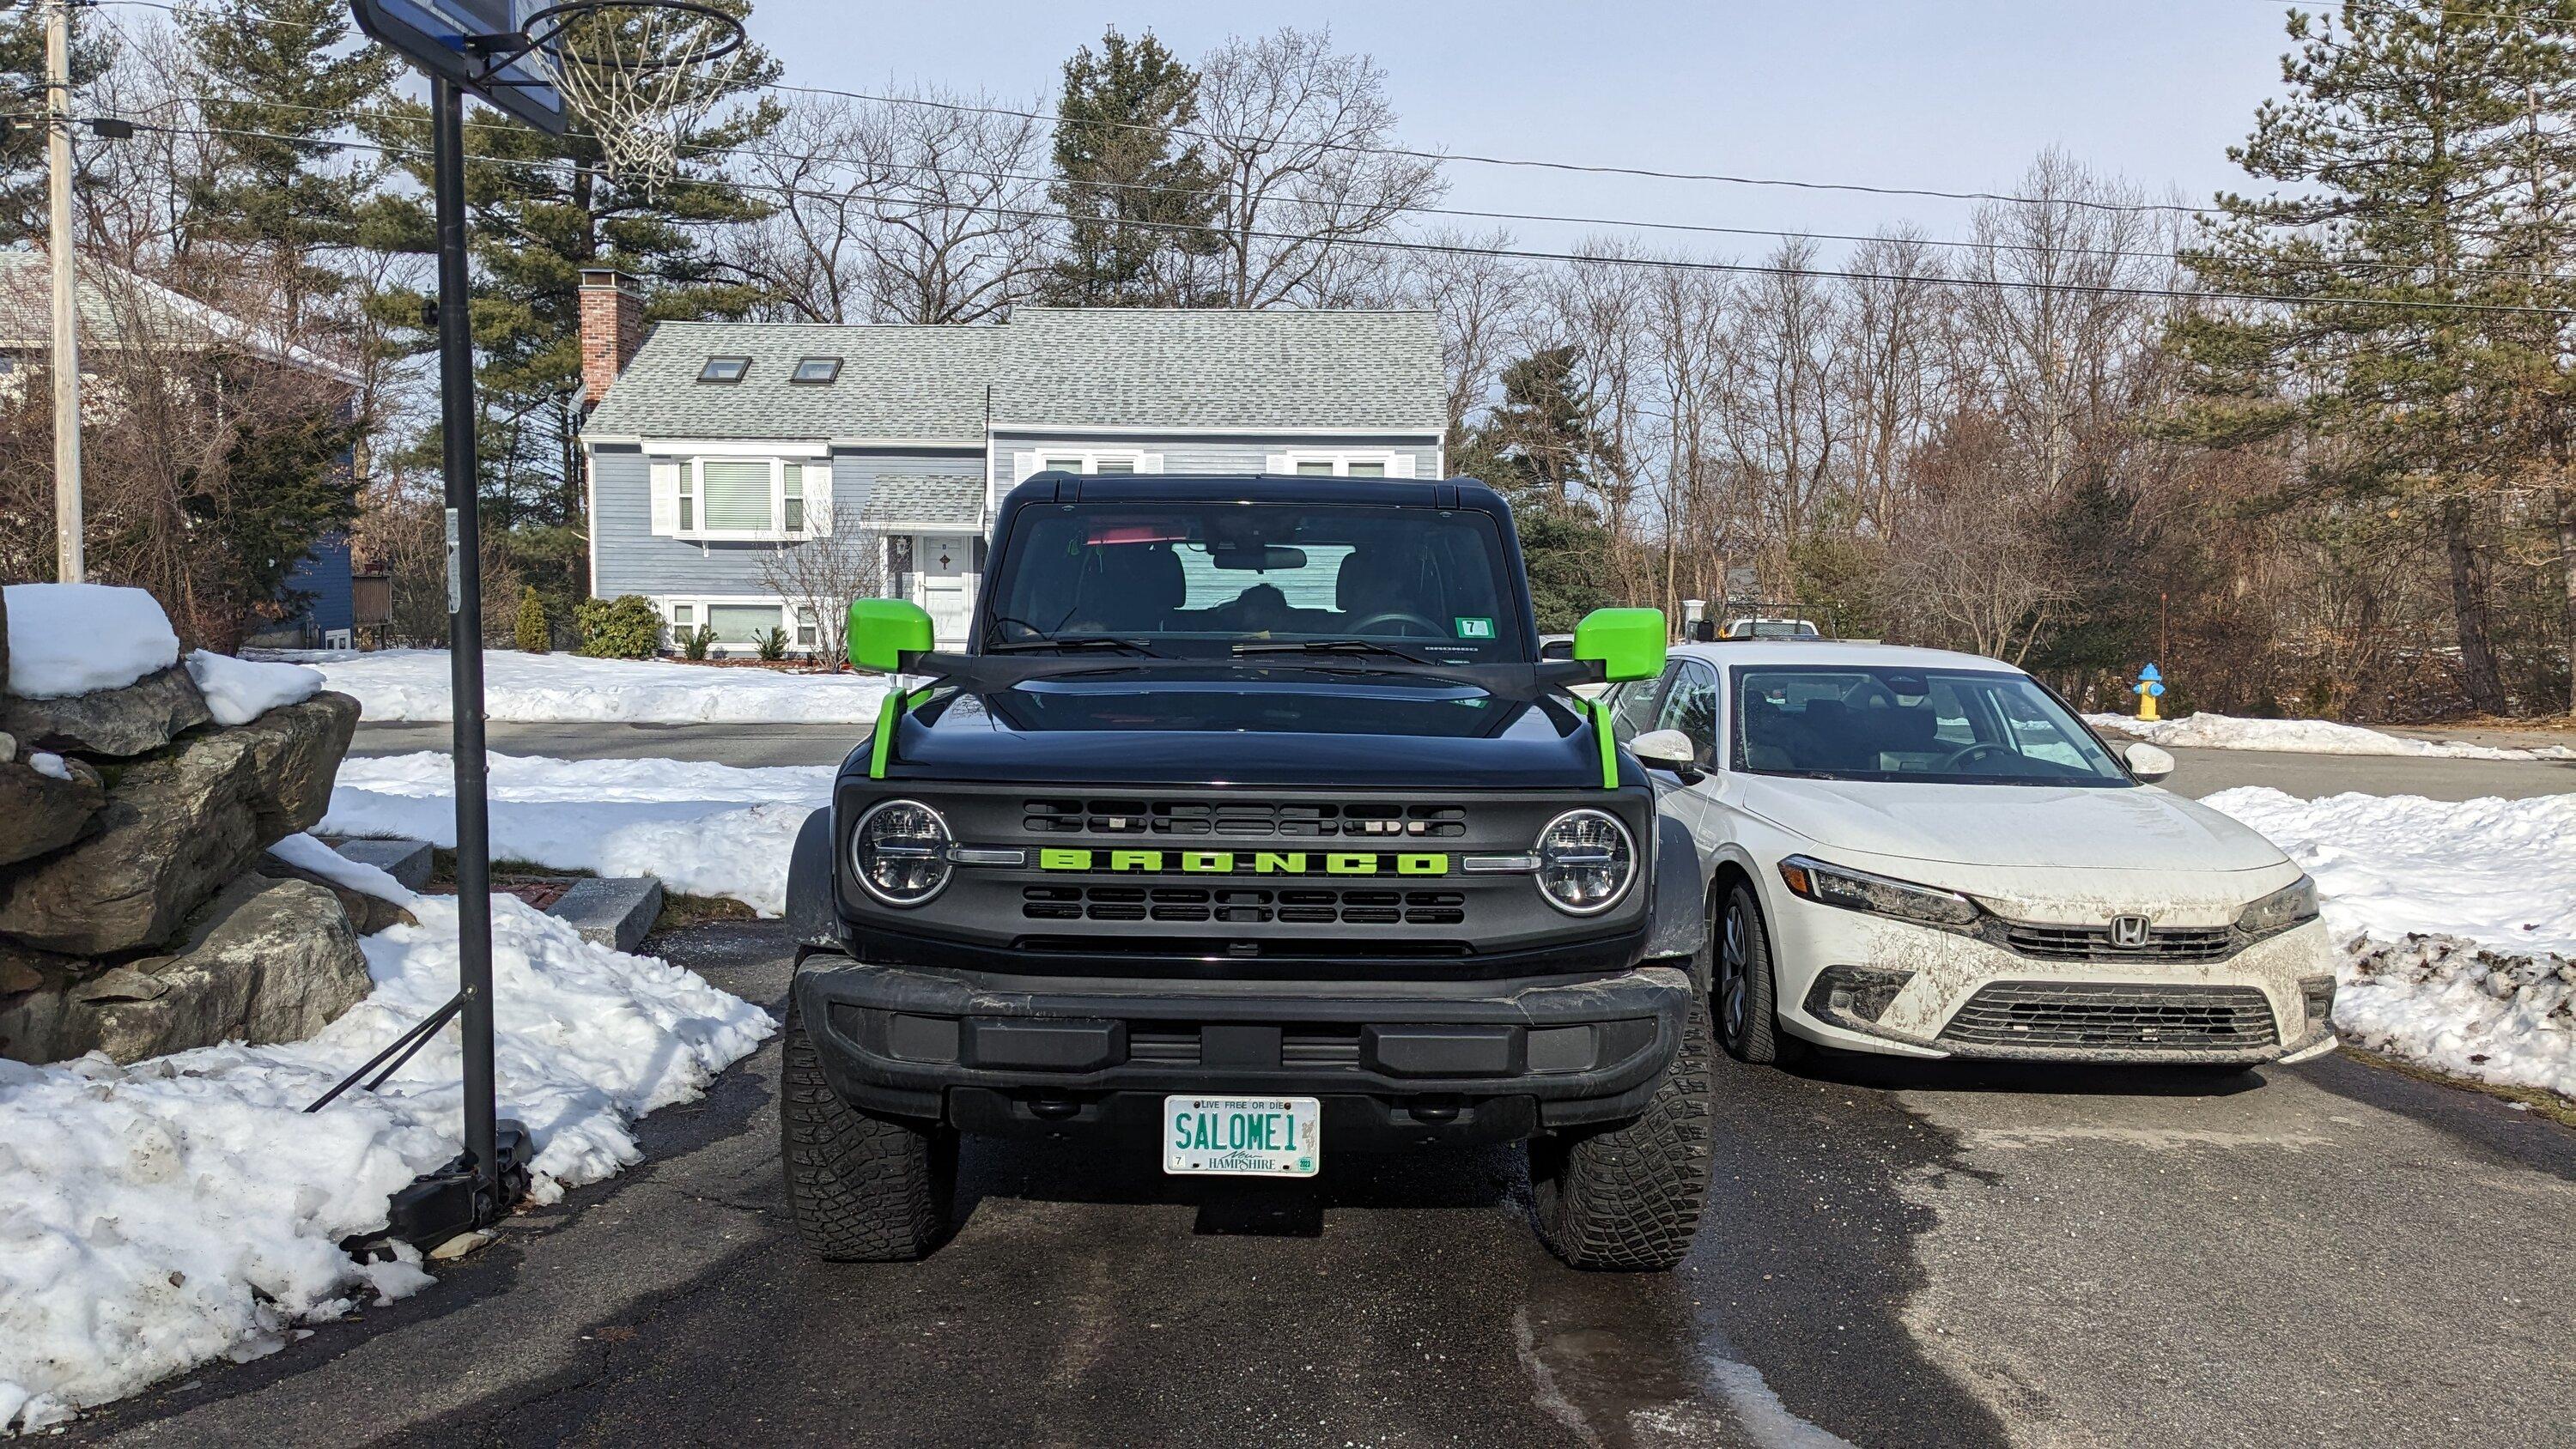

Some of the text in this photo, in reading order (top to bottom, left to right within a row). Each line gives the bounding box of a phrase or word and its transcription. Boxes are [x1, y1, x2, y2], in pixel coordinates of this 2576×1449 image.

[1467, 621, 1474, 633] 7
[1040, 847, 1449, 875] BRONCO
[1201, 1100, 1220, 1109] LIVE
[1175, 1113, 1297, 1151] SALOME1
[1175, 1156, 1182, 1165] 7
[1221, 1150, 1263, 1159] New
[1209, 1158, 1276, 1171] HAMPSHIRE
